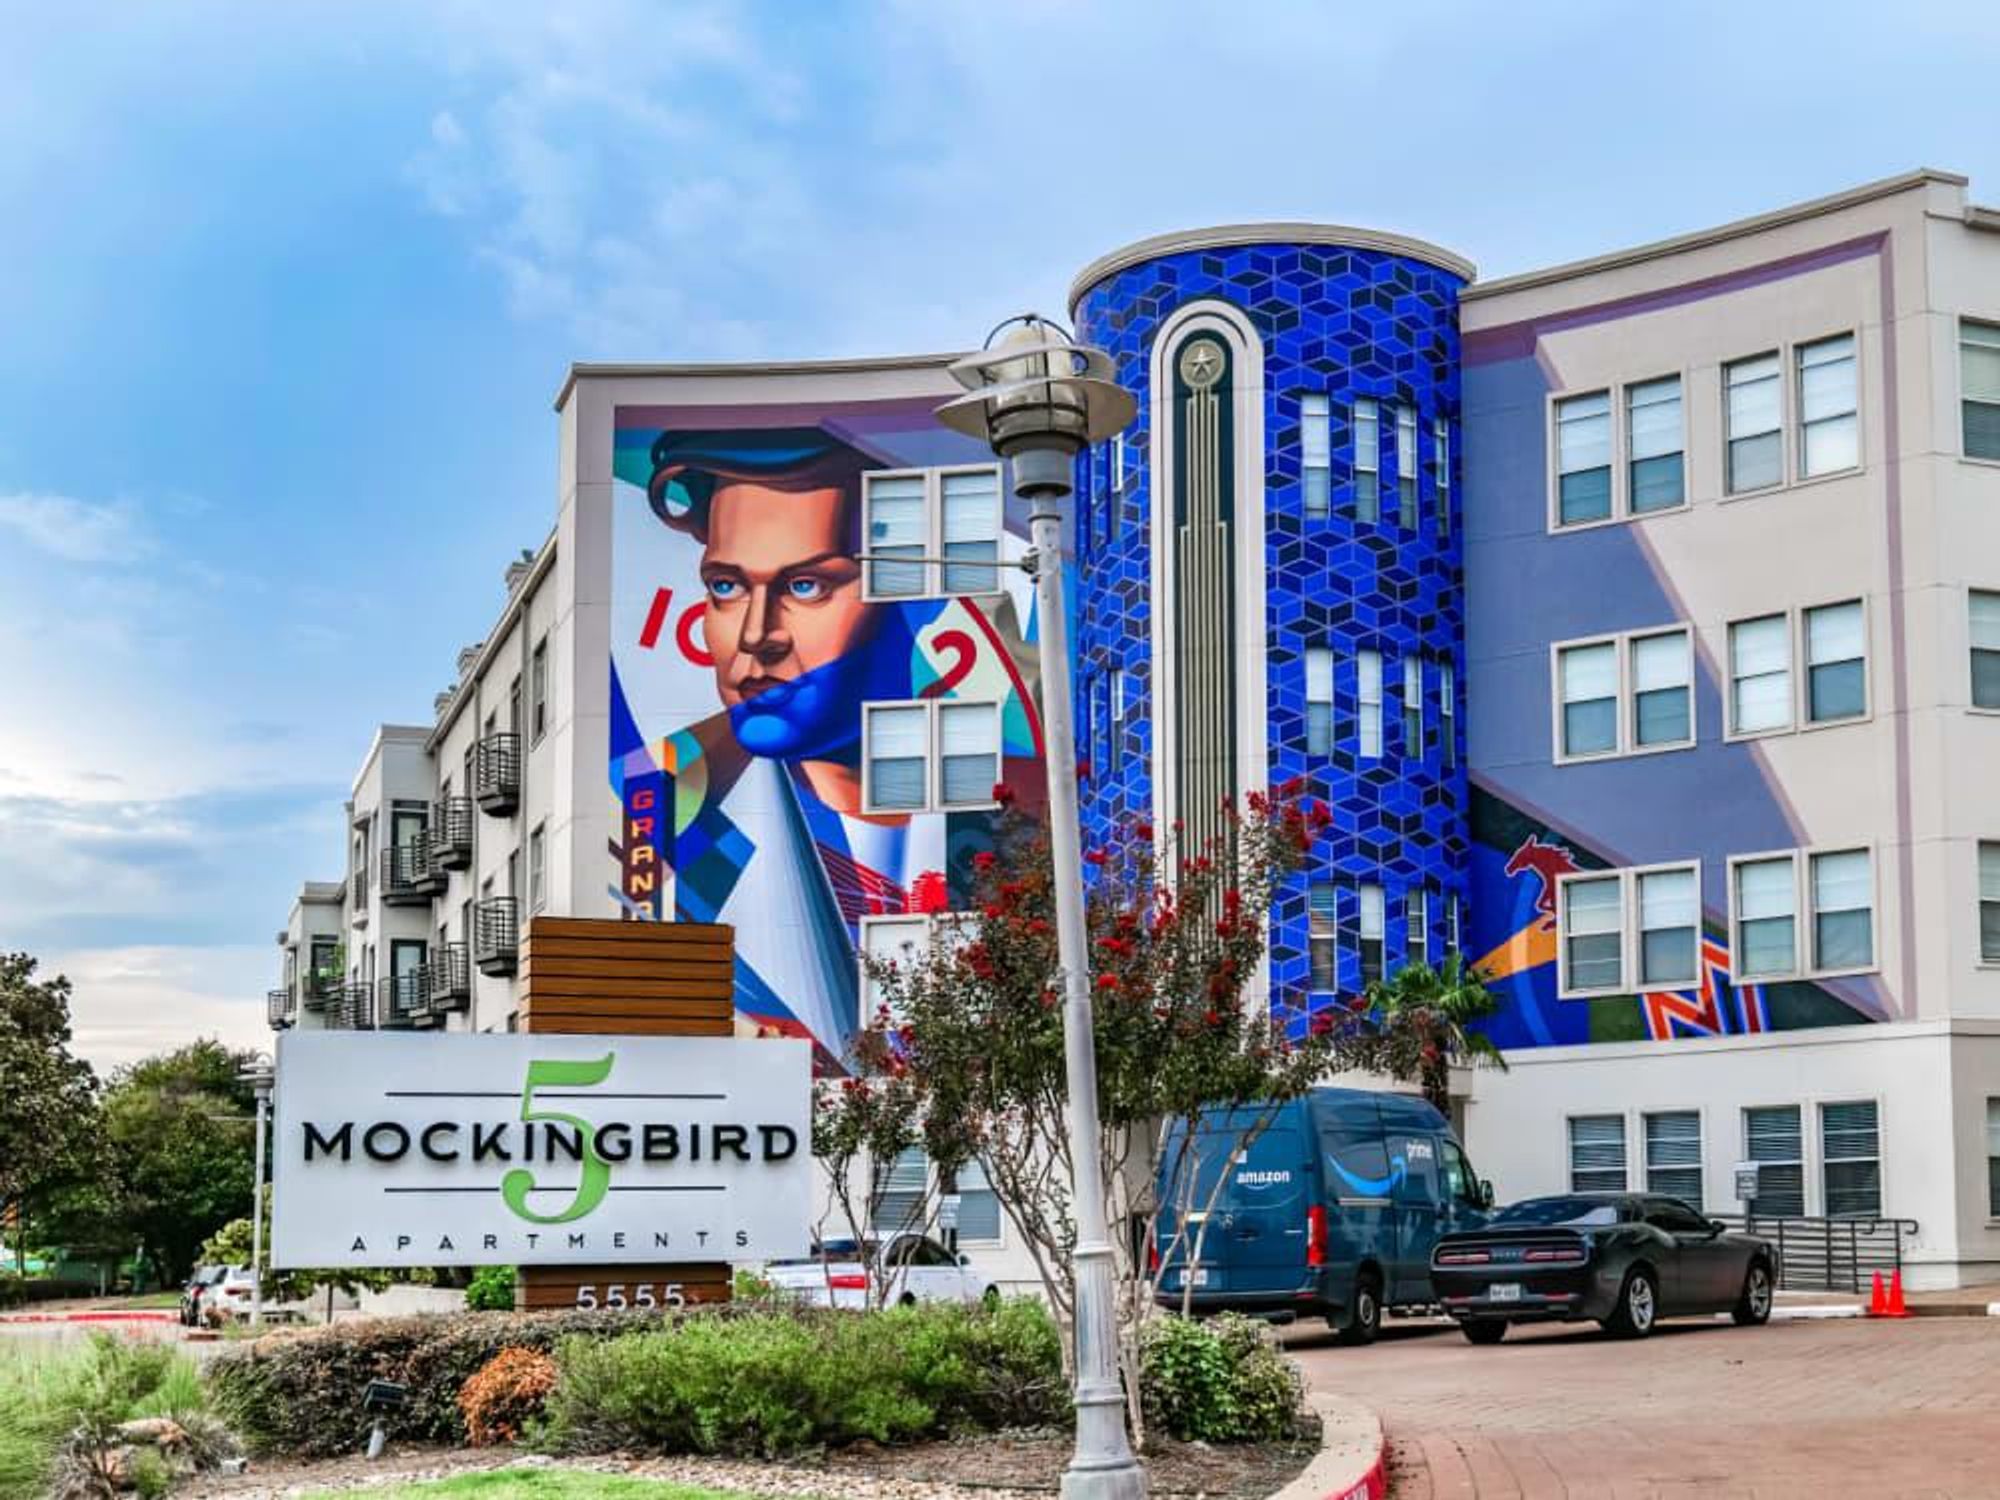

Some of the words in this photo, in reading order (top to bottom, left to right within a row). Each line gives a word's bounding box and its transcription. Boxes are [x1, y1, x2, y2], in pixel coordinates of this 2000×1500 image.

[302, 1121, 798, 1163] MOCKINGBIRD
[502, 1051, 615, 1224] 5
[1236, 1170, 1290, 1184] amazon
[351, 1230, 750, 1253] APARTMENTS
[576, 1283, 686, 1312] 5555
